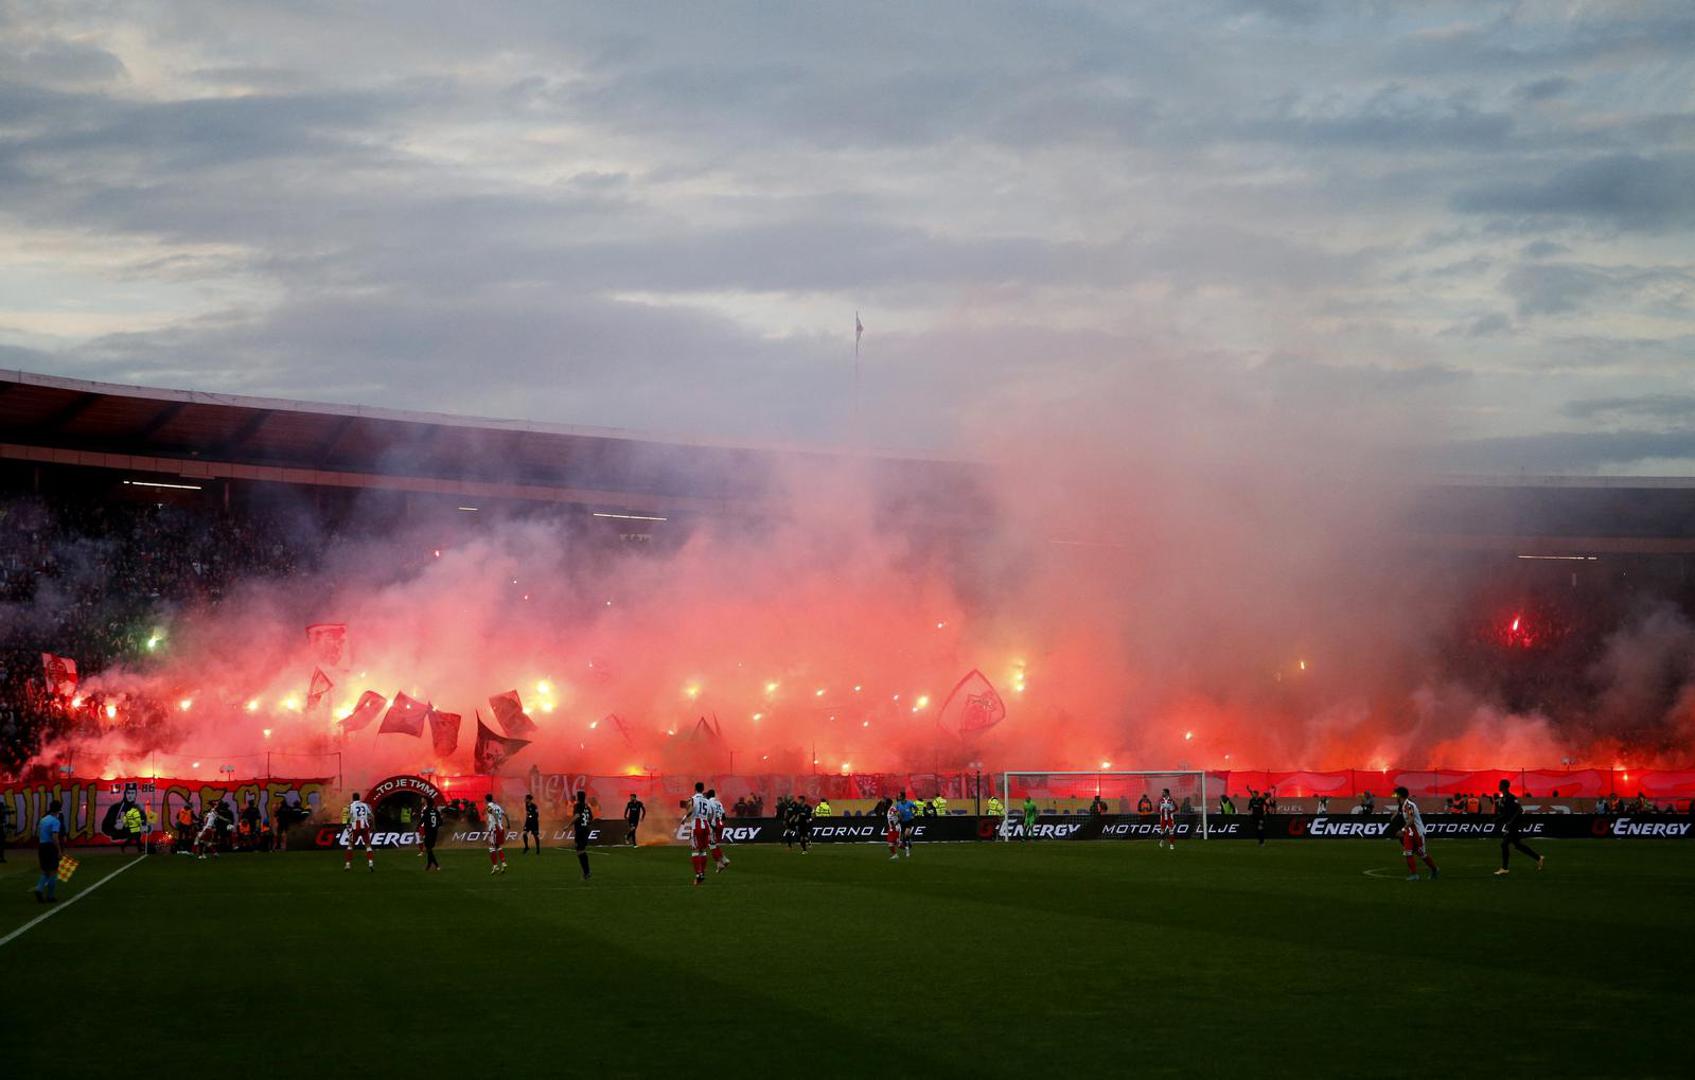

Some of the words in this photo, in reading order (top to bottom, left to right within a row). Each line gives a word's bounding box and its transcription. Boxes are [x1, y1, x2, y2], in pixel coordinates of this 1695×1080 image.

[699, 801, 708, 816] 15
[430, 815, 437, 828] 9
[1424, 823, 1496, 833] OTORNO
